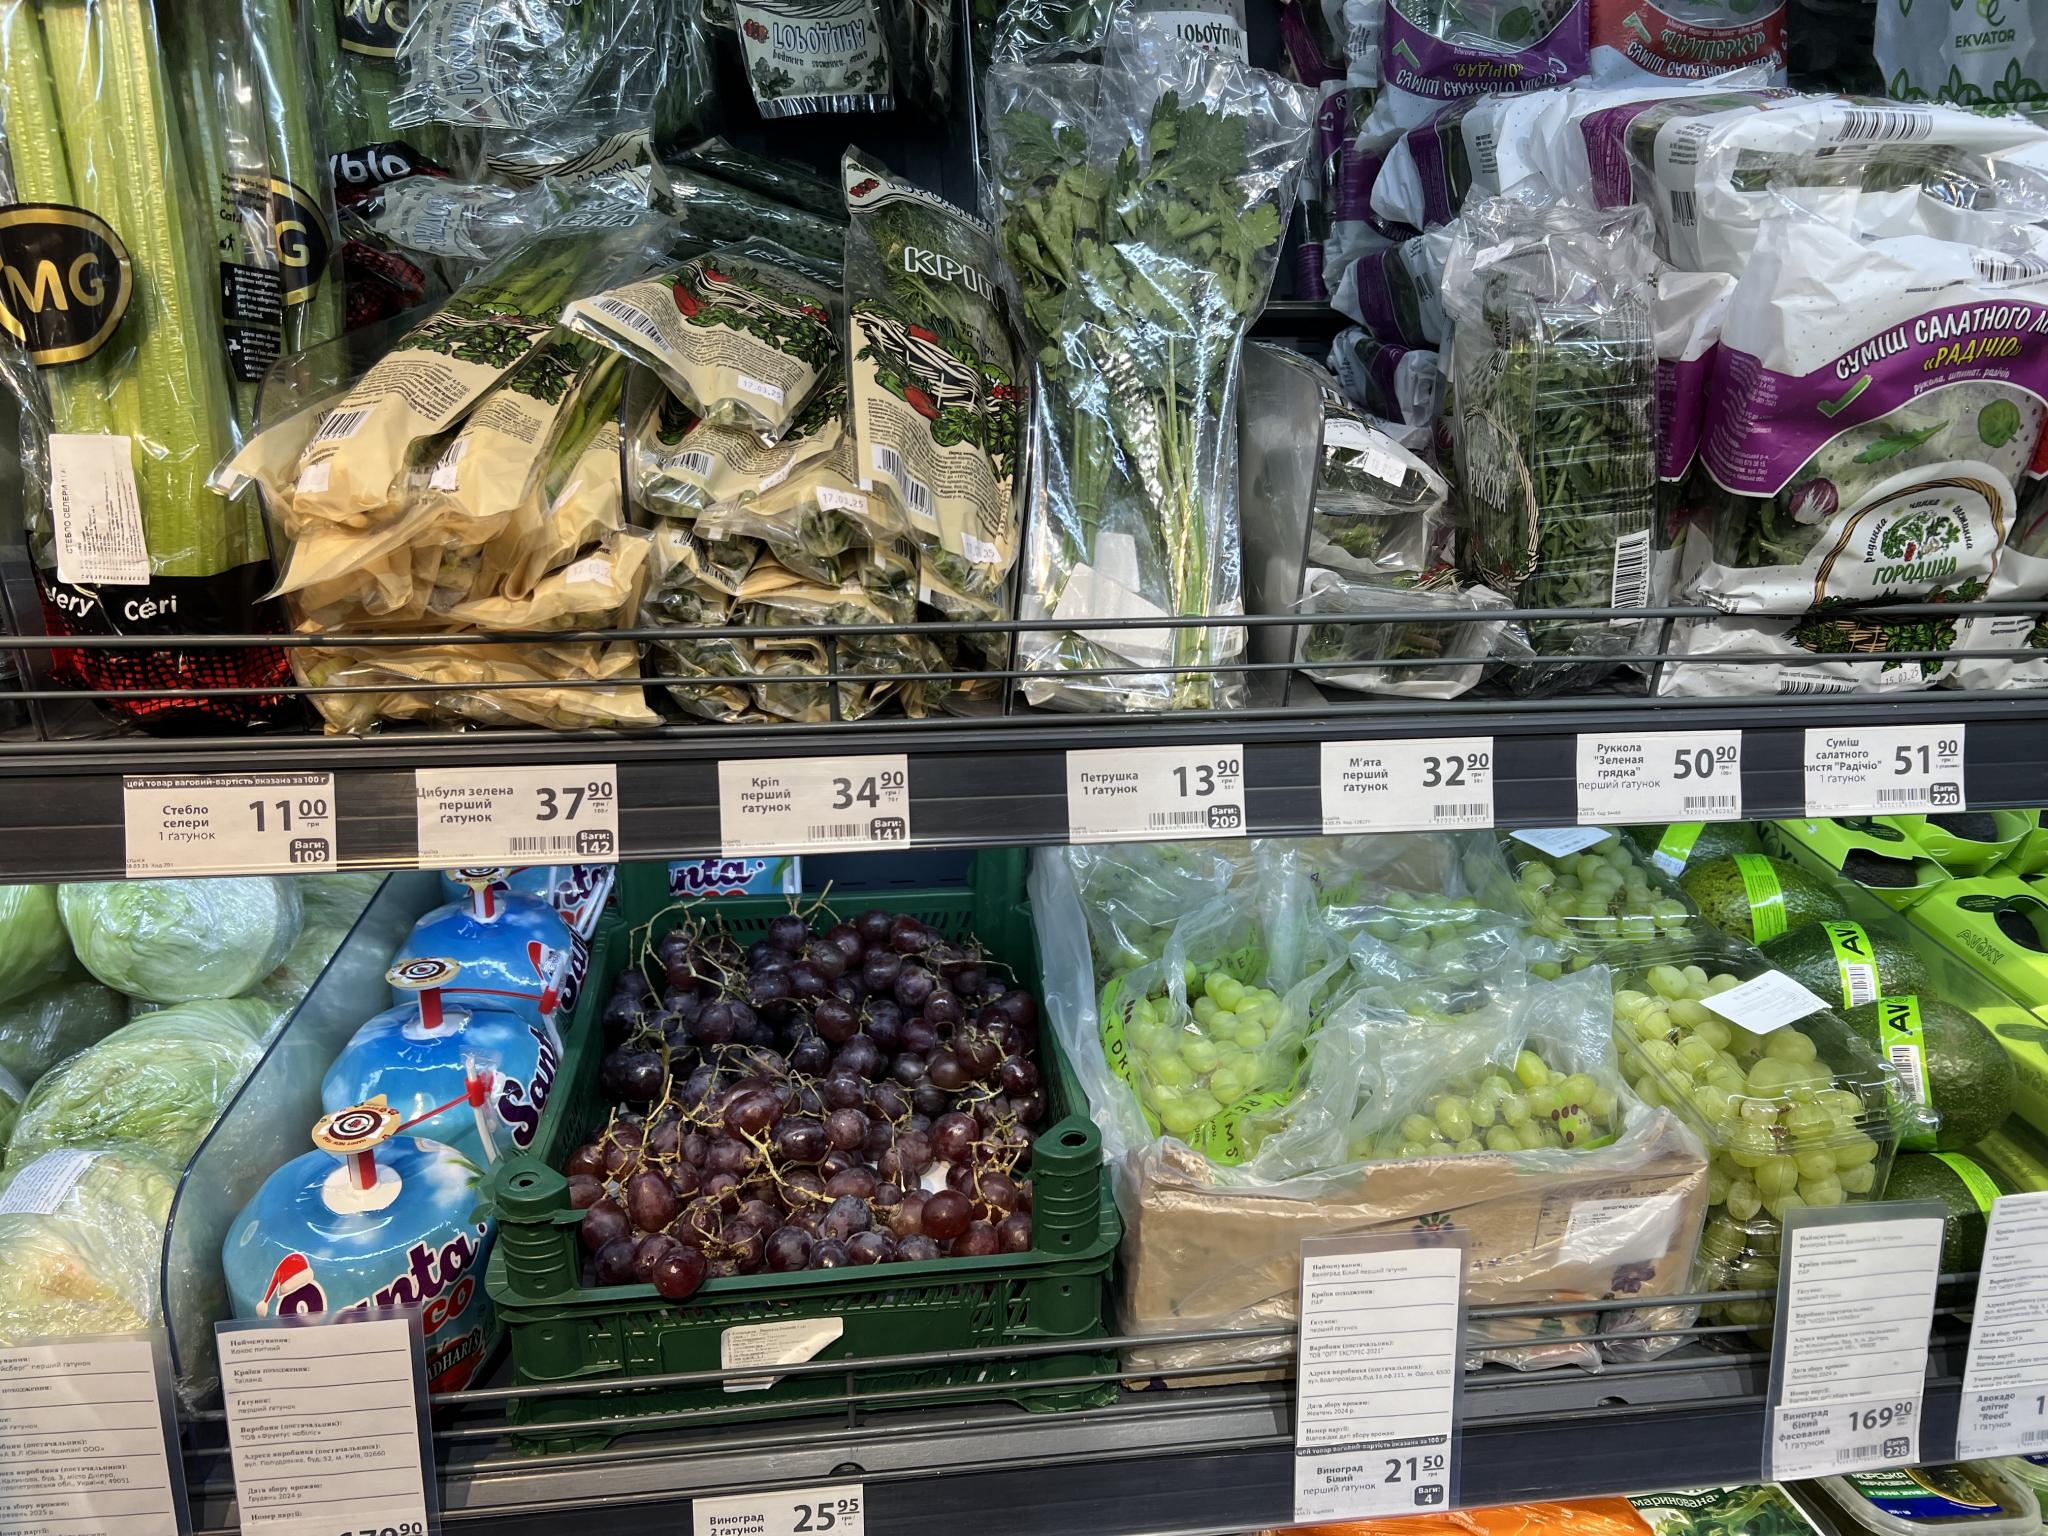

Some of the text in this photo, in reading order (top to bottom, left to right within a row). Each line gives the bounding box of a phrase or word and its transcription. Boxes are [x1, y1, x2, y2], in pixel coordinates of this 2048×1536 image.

[1956, 29, 2015, 48] EKVATOR
[4, 251, 105, 313] MG
[1836, 306, 2032, 380] СУМІШ САЛАТНОГО
[1924, 336, 2022, 372] «РАДІЧІО»
[1872, 556, 1957, 586] ГОРОДИНА
[1597, 744, 1641, 754] Руккола
[1827, 738, 1859, 748] Суміш
[1938, 740, 1958, 754] 90
[1716, 746, 1737, 760] 90
[1816, 750, 1868, 760] салатного
[1467, 753, 1489, 768] 90
[1594, 755, 1644, 765] "Зеленая
[1673, 749, 1715, 779] 50
[1895, 745, 1929, 775] 51
[1217, 760, 1239, 775] 90
[1423, 756, 1465, 787] 32
[1835, 761, 1881, 772] "Радічіо"
[881, 771, 904, 786] 90
[1081, 772, 1138, 784] Петрушка
[1343, 771, 1388, 781] перший
[1598, 767, 1641, 779] грядка"
[1828, 774, 1866, 784] ґатунок
[146, 778, 171, 788] товар
[303, 775, 318, 784] 100
[752, 777, 779, 788] Кріп
[1173, 765, 1215, 797] 13
[1578, 779, 1660, 791] перший ґатунок
[416, 787, 513, 798] Цибуля зелена
[588, 782, 613, 797] 90
[833, 777, 880, 810] 34
[1084, 785, 1138, 796] 1 ґатунок
[1343, 783, 1388, 793] ґатунок
[1933, 784, 1956, 792] Ваги:
[741, 789, 791, 802] перший
[1933, 794, 1957, 805] 220
[163, 805, 208, 815] Стебло
[299, 799, 327, 816] 00
[439, 799, 491, 811] перший
[536, 787, 585, 821] 37
[742, 803, 791, 814] ґатунок
[250, 800, 291, 832] 11
[1212, 807, 1237, 815] Ваги:
[163, 820, 209, 829] селери
[441, 813, 492, 825] ґатунок
[875, 820, 901, 828] Ваги:
[1212, 816, 1239, 828] 209
[168, 830, 215, 843] ґатунок
[581, 833, 610, 841] Ваги:
[875, 829, 901, 840] 141
[295, 841, 325, 849] Ваги:
[581, 842, 610, 854] 142
[294, 851, 326, 862] 109
[1977, 1391, 2016, 1403] Авокадо
[1895, 1401, 1913, 1414] 90
[1981, 1402, 2009, 1412] елітне
[1783, 1410, 1829, 1422] Виноград
[1850, 1407, 1893, 1432] 169
[1979, 1411, 2009, 1422] "Reed"
[1792, 1419, 1819, 1430] білий
[1779, 1428, 1831, 1442] фасований
[1886, 1446, 1908, 1458] 228
[1423, 1454, 1444, 1468] 50
[1317, 1465, 1363, 1476] Виноград
[1385, 1457, 1417, 1483] 21
[1327, 1474, 1353, 1484] Білий
[1304, 1485, 1340, 1496] перший
[838, 1498, 859, 1512] 95
[1425, 1494, 1432, 1504] 4
[710, 1514, 764, 1526] Виноград
[794, 1502, 835, 1532] 25
[400, 1522, 422, 1534] 90
[720, 1526, 764, 1536] ґатунок
